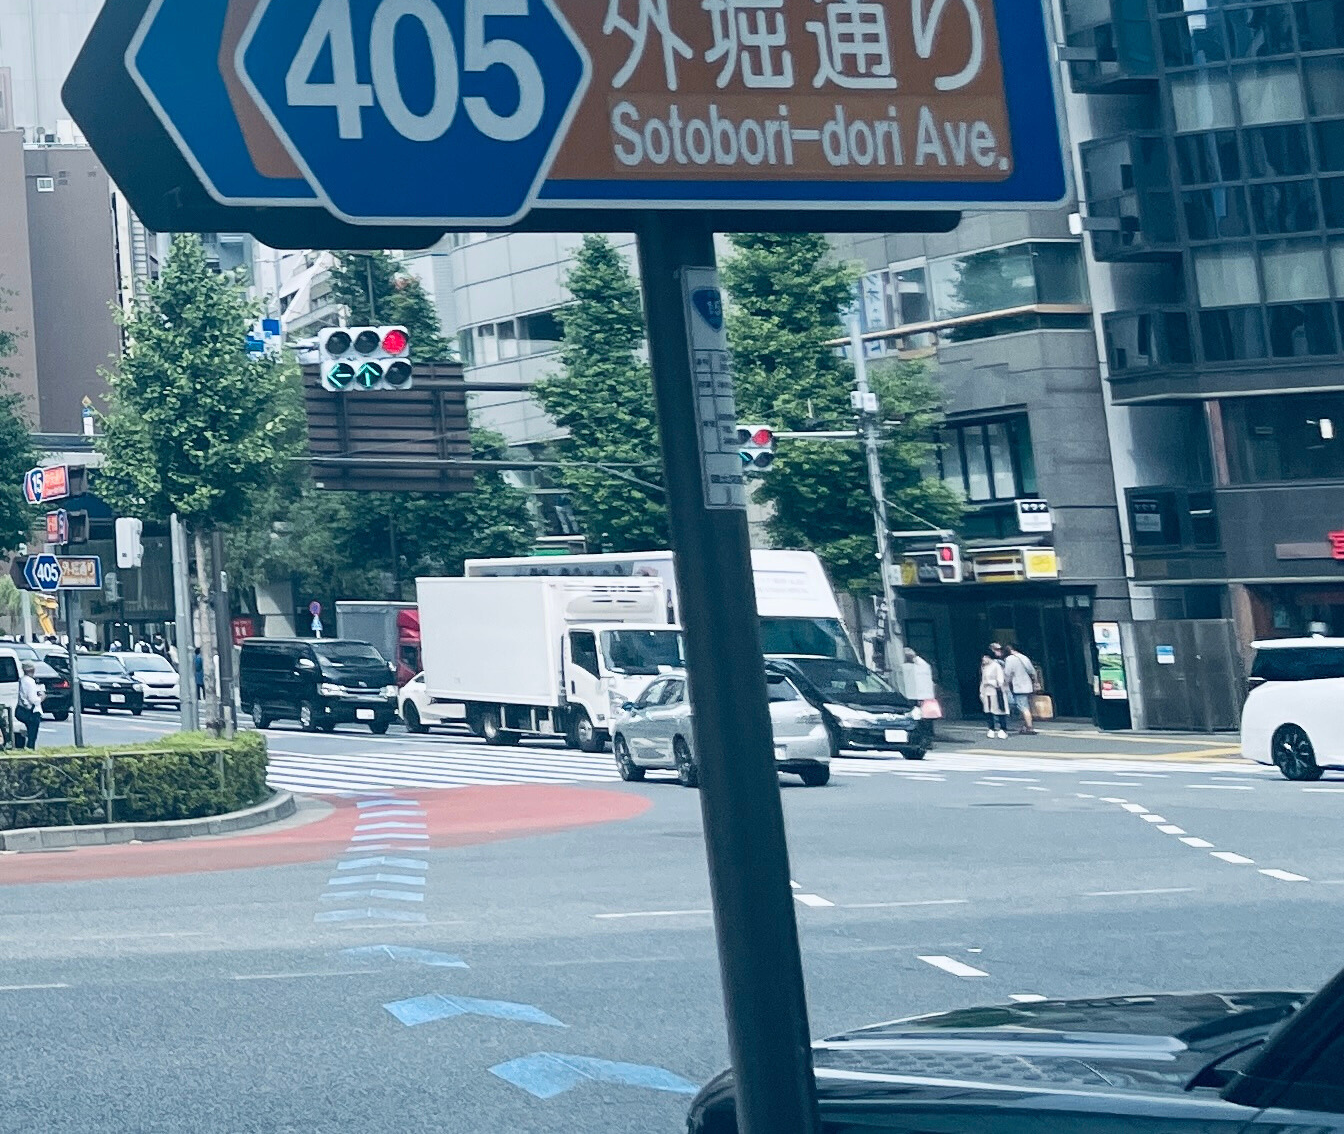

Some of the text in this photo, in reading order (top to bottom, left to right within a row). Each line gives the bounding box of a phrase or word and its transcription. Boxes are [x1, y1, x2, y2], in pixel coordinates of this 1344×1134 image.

[613, 102, 1011, 171] Sotobori-dori Ave.
[32, 473, 42, 494] 15
[37, 563, 59, 582] 405
